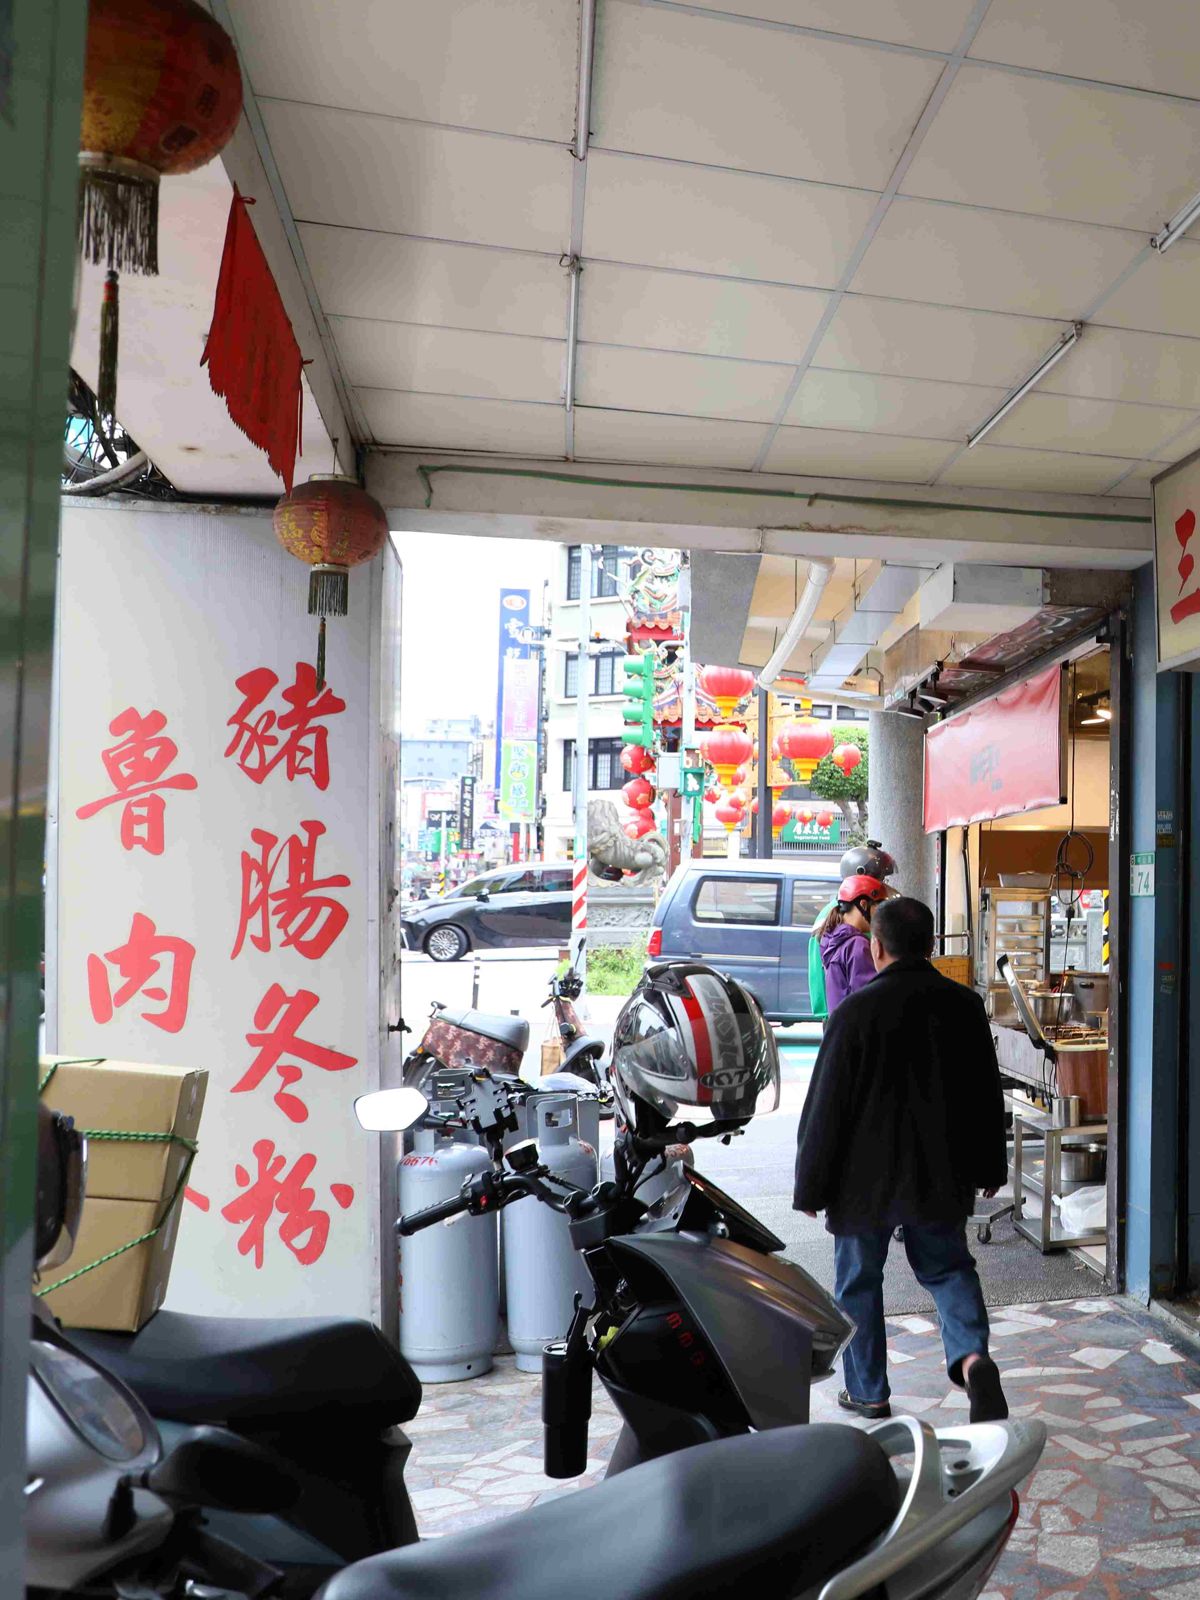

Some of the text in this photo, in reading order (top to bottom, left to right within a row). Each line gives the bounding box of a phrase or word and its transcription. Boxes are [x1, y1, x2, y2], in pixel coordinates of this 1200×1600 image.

[76, 707, 209, 1212] 魯肉
[223, 662, 358, 1270] 豬腸冬粉
